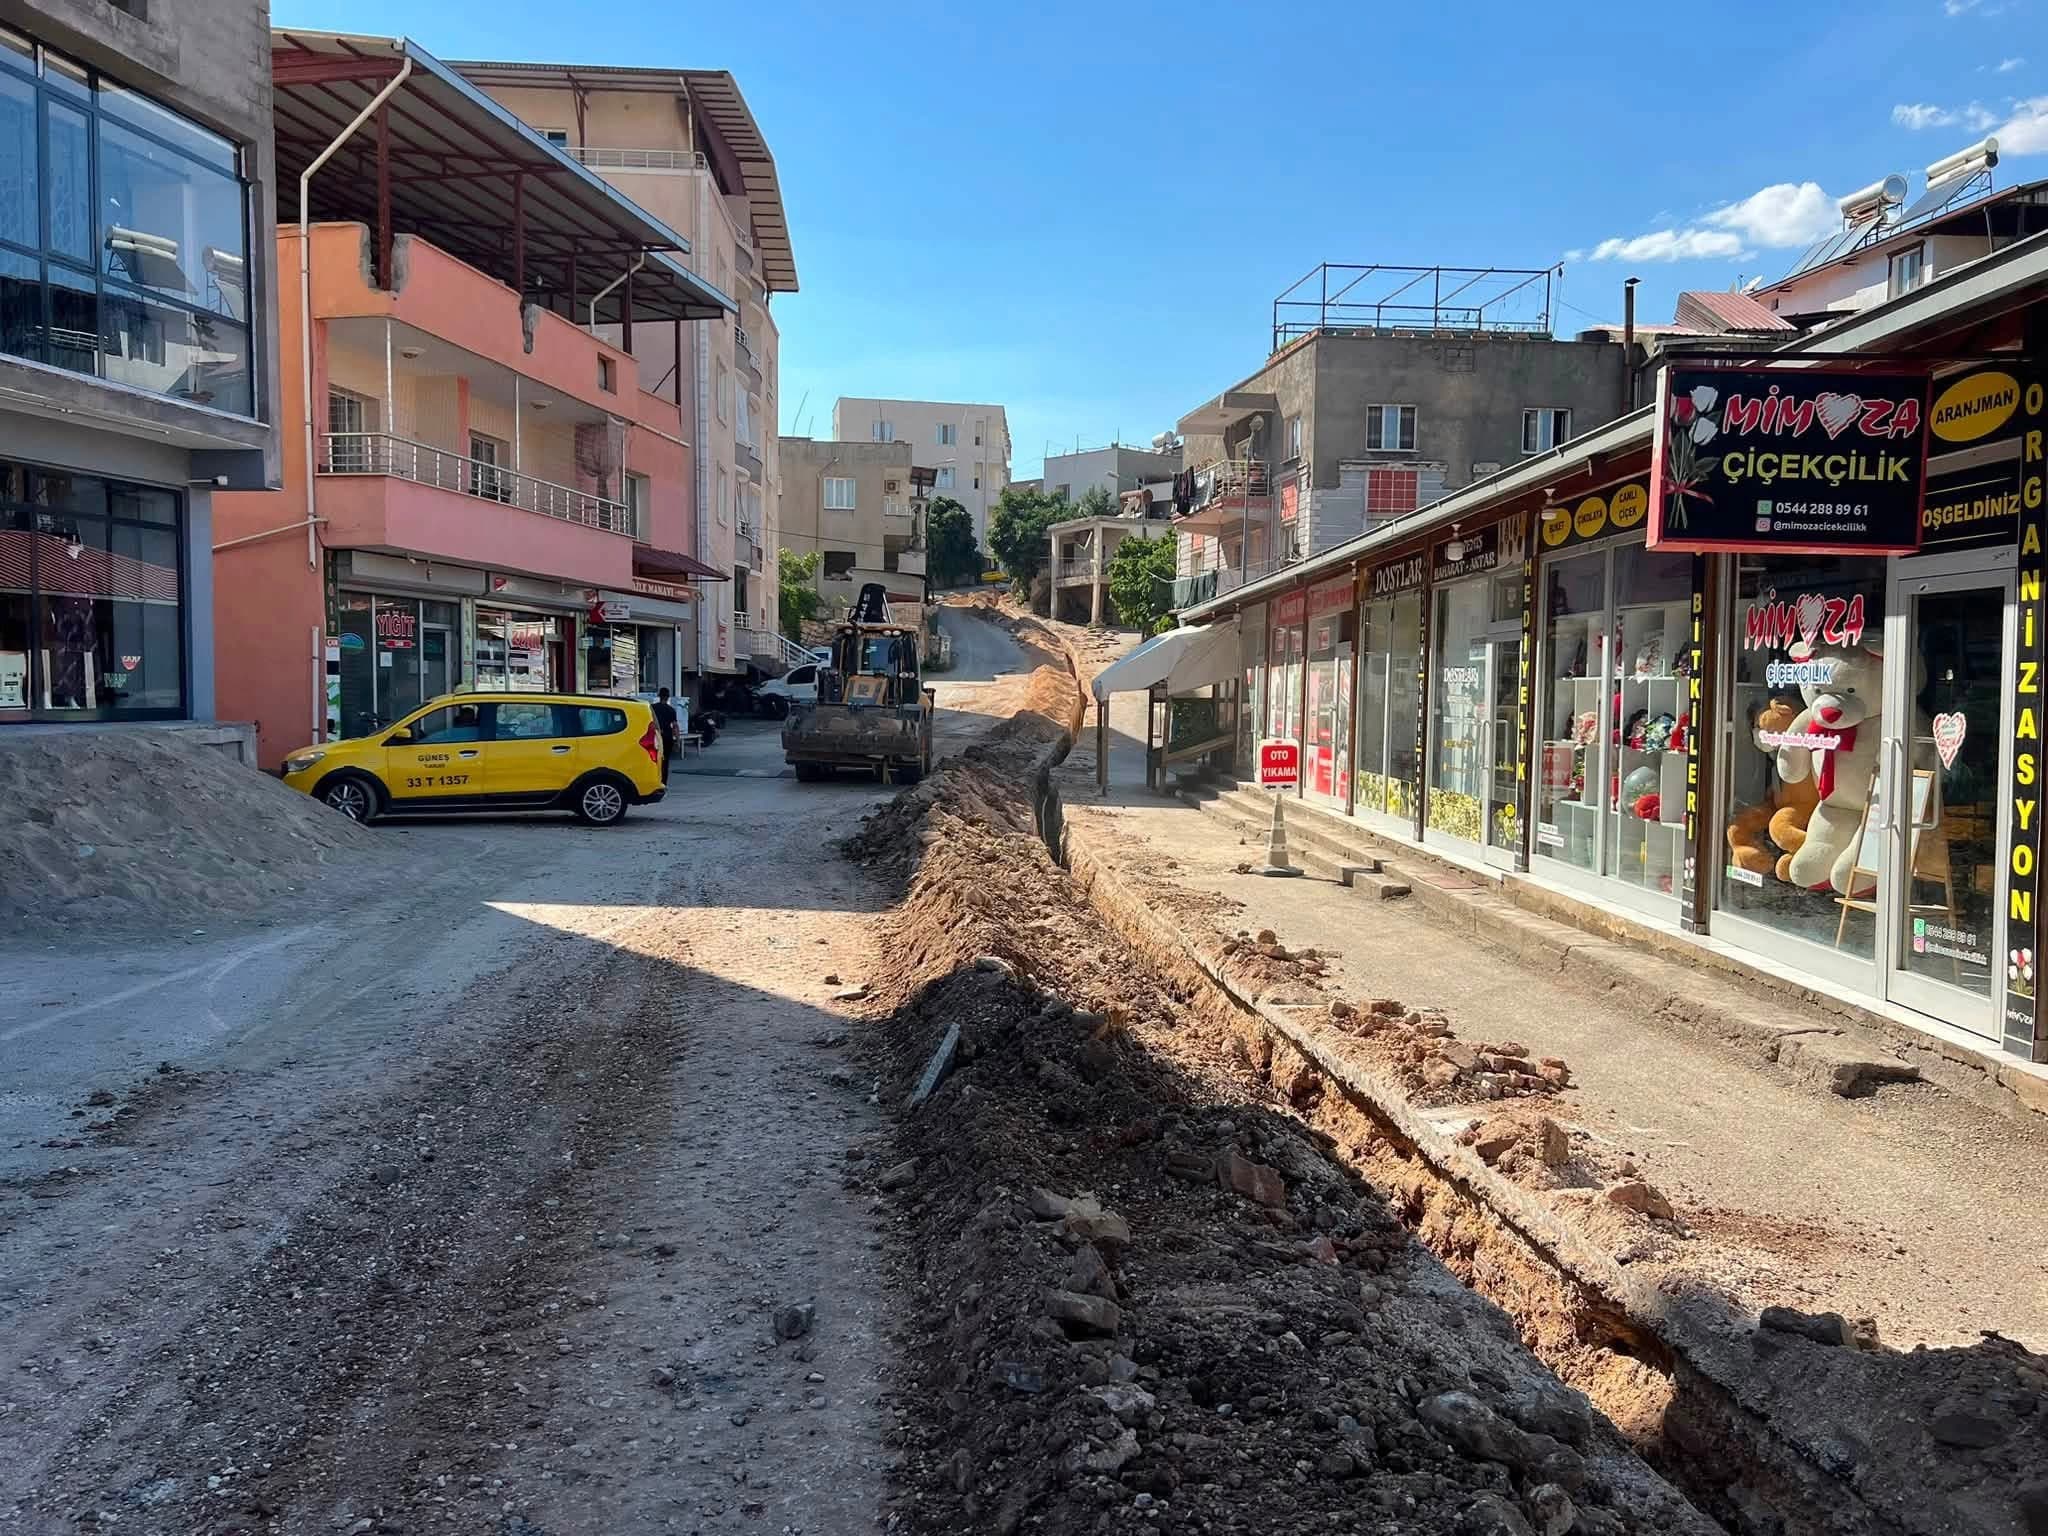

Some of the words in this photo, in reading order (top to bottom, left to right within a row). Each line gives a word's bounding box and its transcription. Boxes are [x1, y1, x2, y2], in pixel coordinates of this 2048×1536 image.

[1935, 389, 2014, 425] ARANJMAN
[1721, 446, 1910, 487] ÇİÇEKÇİLİK
[1619, 490, 1638, 503] CANLI
[1619, 506, 1638, 521] ÇİÇEK
[1775, 502, 1808, 514] 0544
[1809, 503, 1833, 515] 288
[1835, 504, 1852, 515] 89
[1853, 504, 1869, 516] 61
[1921, 491, 2021, 531] OŞGELDİNİZ
[1375, 557, 1423, 593] DOSTLAR
[376, 610, 415, 637] YİĞİT
[1766, 659, 1833, 688] ÇİÇEKÇİLİK
[1270, 750, 1289, 761] OTO
[407, 777, 422, 788] 33
[425, 776, 435, 787] T
[439, 774, 470, 786] 1357
[1262, 766, 1297, 777] YIKAMA
